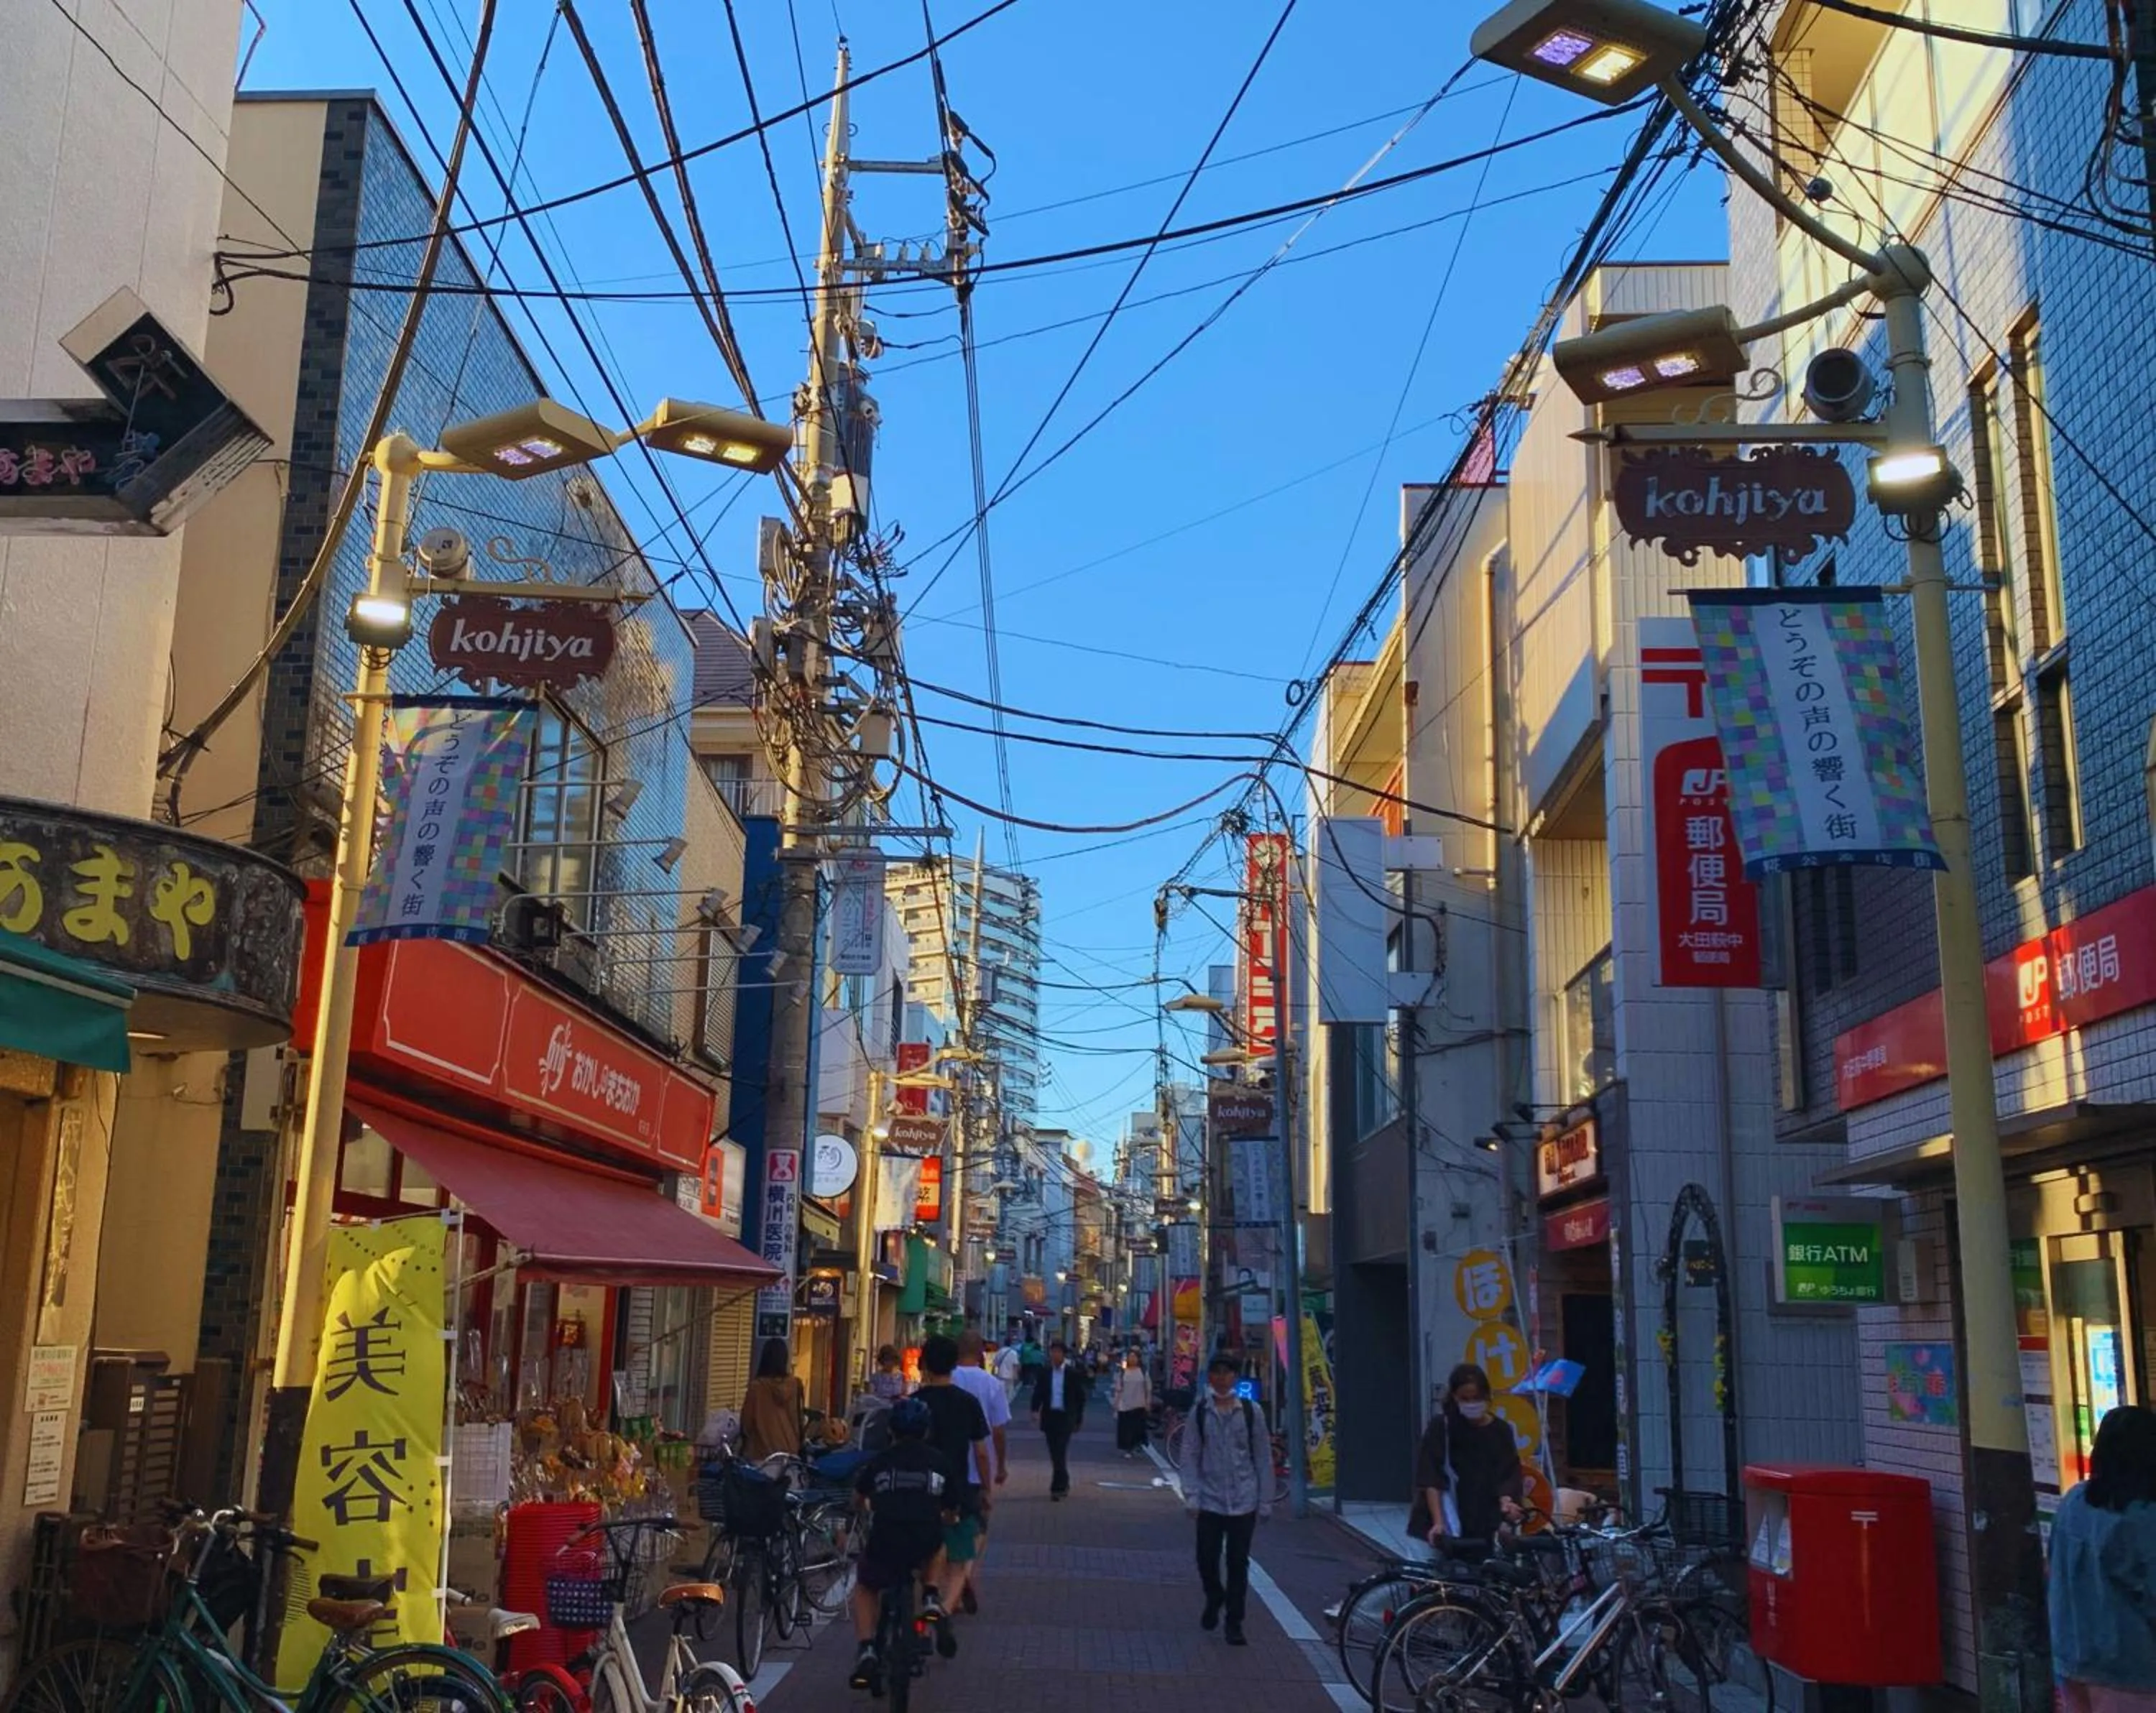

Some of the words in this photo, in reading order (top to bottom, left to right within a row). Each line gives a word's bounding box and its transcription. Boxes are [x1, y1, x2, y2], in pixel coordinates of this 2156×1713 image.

[1645, 476, 1830, 525] kohjiya
[451, 618, 594, 662] kohjiya
[1686, 816, 1728, 925] 郵便局
[2019, 955, 2047, 1009] JP
[2055, 934, 2120, 1001] 郵便局
[763, 1185, 786, 1261] 横川医院
[1788, 1245, 1868, 1262] 銀行ATM
